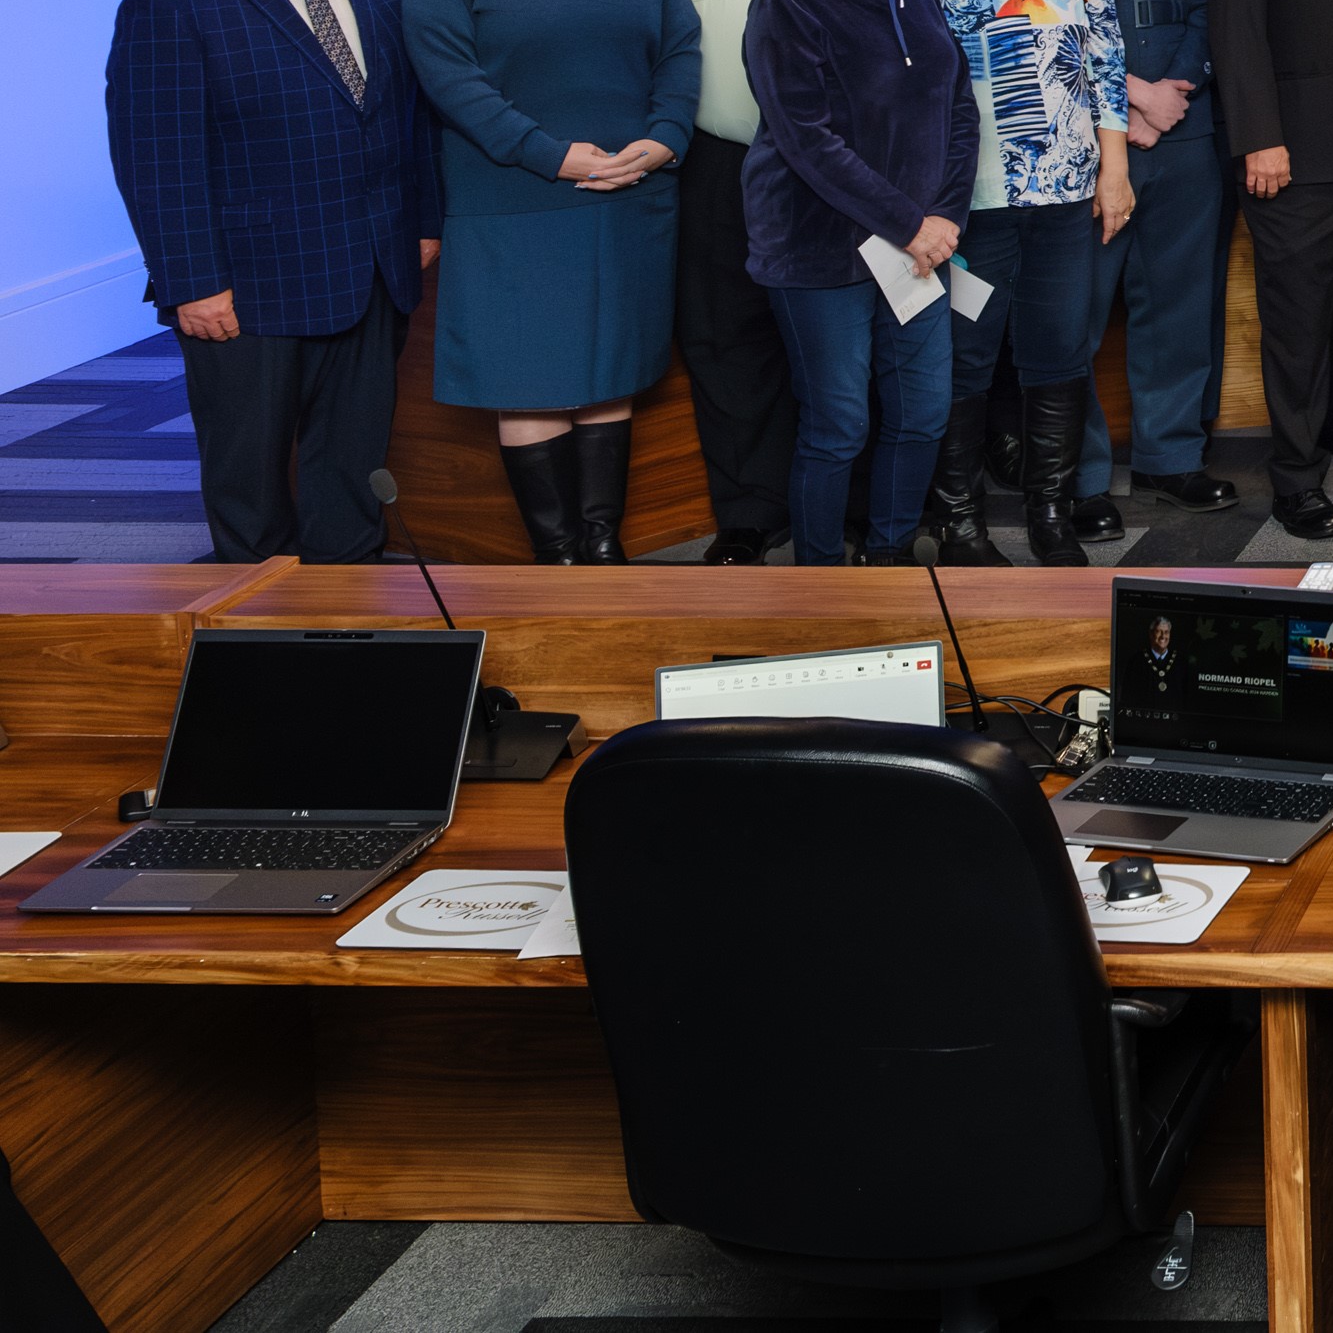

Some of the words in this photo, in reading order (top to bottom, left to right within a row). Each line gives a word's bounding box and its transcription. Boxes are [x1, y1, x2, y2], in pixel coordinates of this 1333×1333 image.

[1198, 673, 1242, 684] NORMAND
[1244, 677, 1276, 687] RIOPEL
[418, 897, 523, 911] Prescott
[438, 908, 549, 921] Russell
